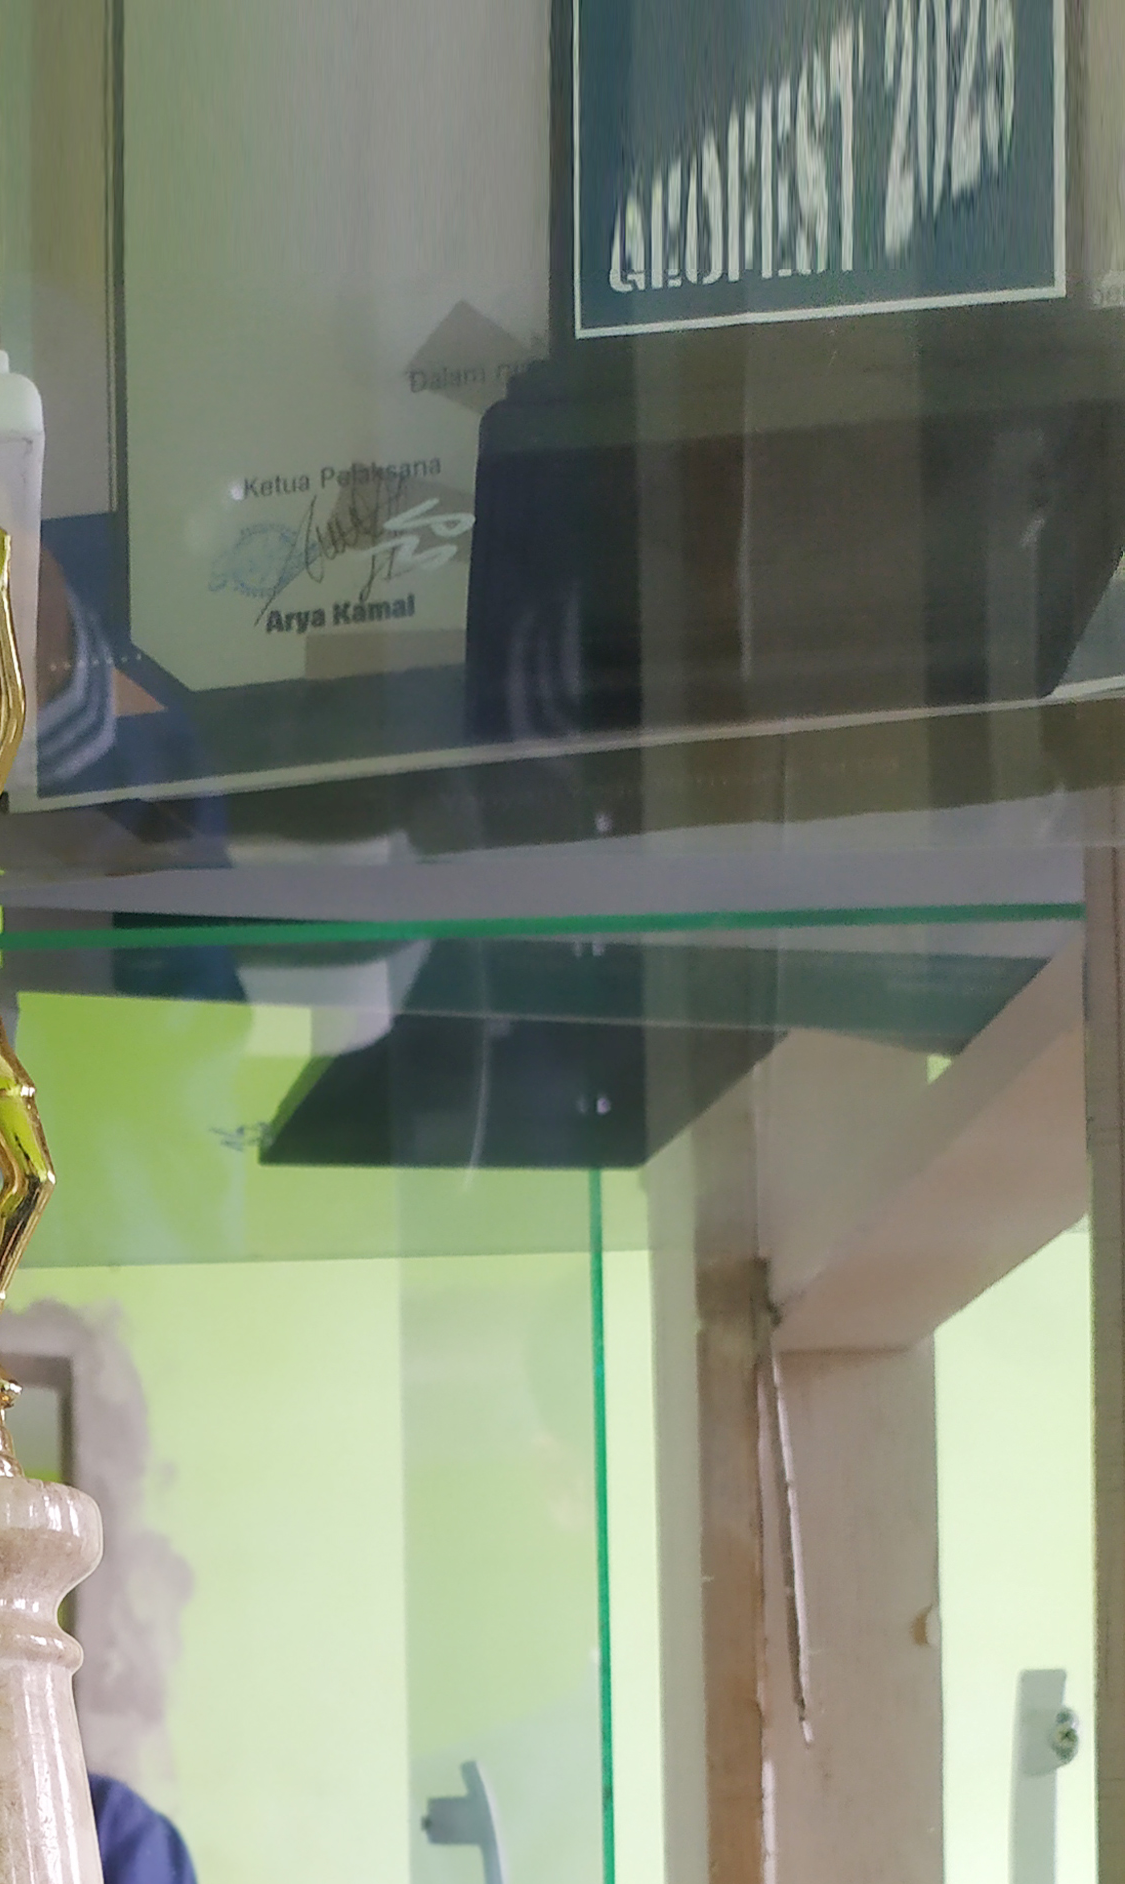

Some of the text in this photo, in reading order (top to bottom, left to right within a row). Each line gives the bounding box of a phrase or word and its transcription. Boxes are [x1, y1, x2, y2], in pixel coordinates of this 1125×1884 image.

[242, 456, 442, 500] Ketua Pelaksana
[266, 594, 416, 634] Arya Kamal
